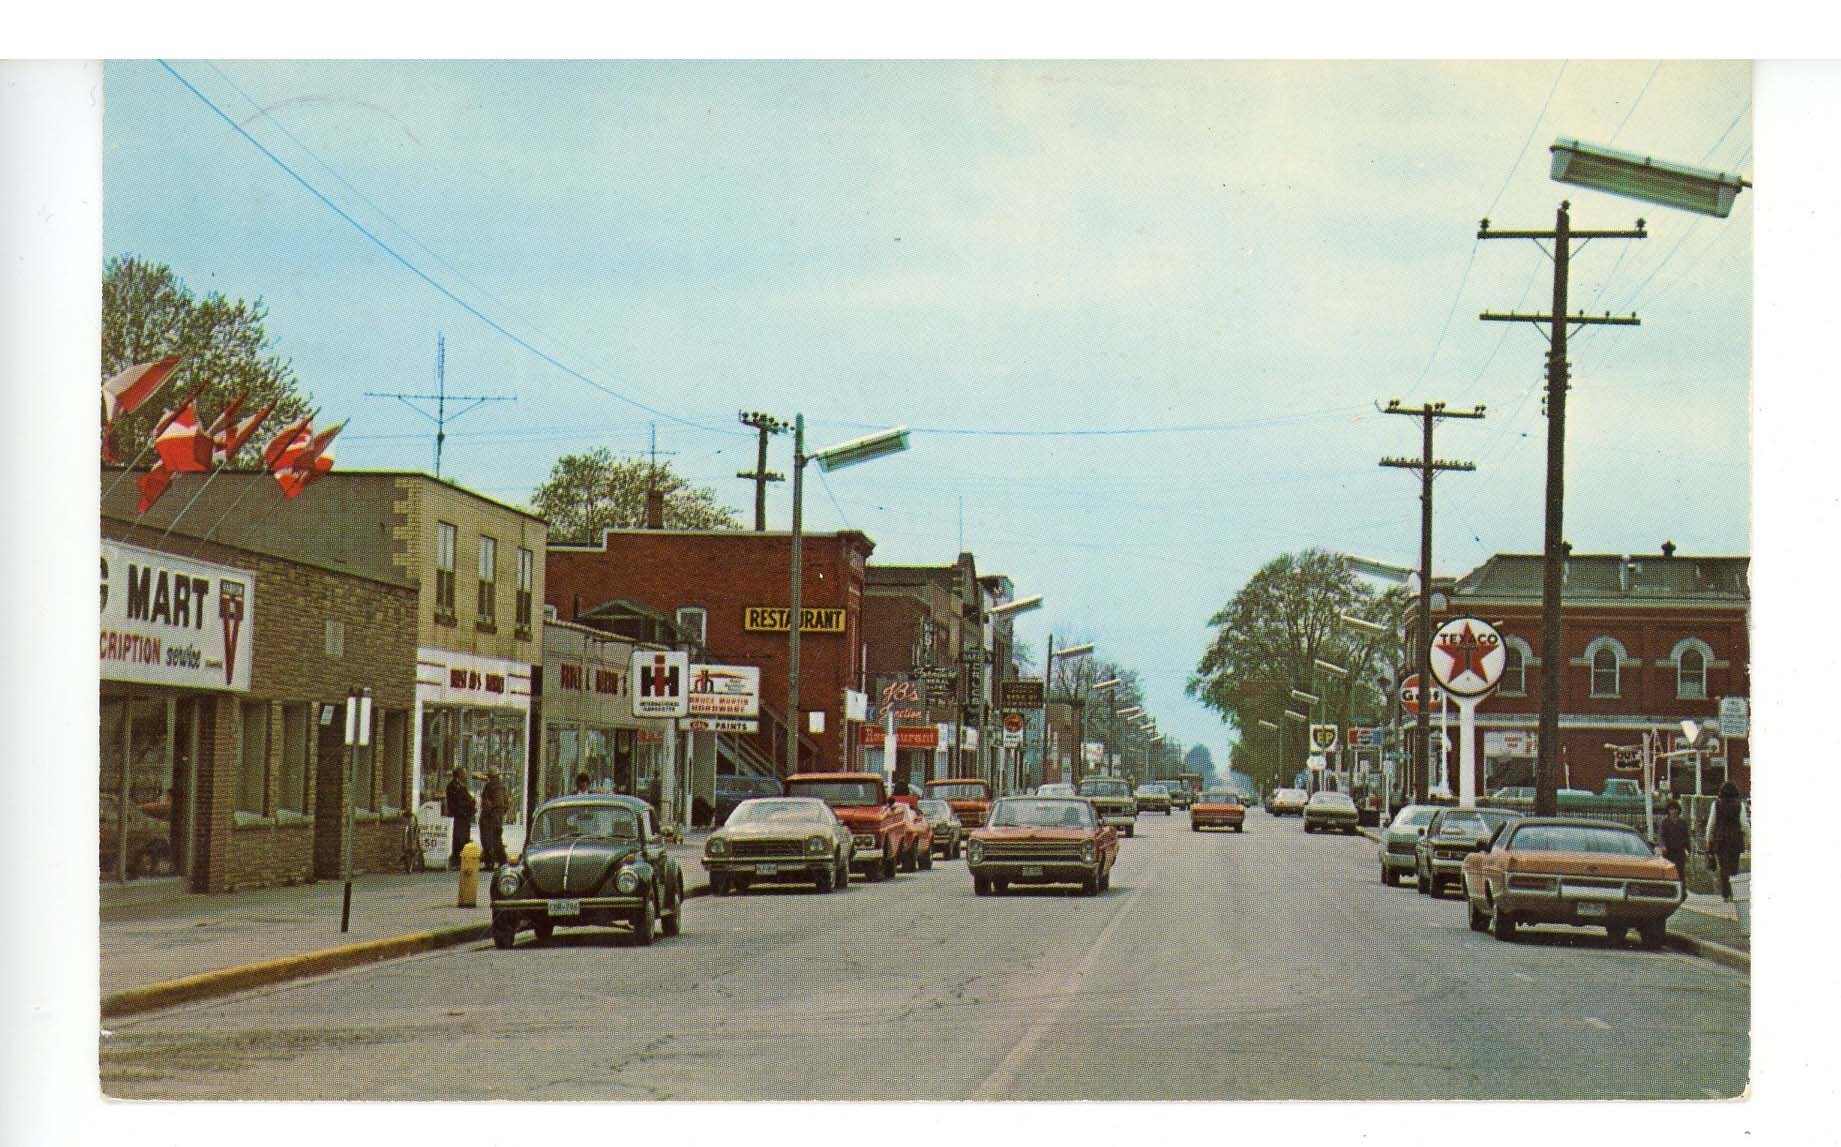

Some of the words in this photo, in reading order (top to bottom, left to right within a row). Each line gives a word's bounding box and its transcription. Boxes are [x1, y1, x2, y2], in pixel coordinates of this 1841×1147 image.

[128, 563, 209, 629] MART
[1440, 633, 1498, 644] TEXACO
[716, 722, 746, 730] PAINTS
